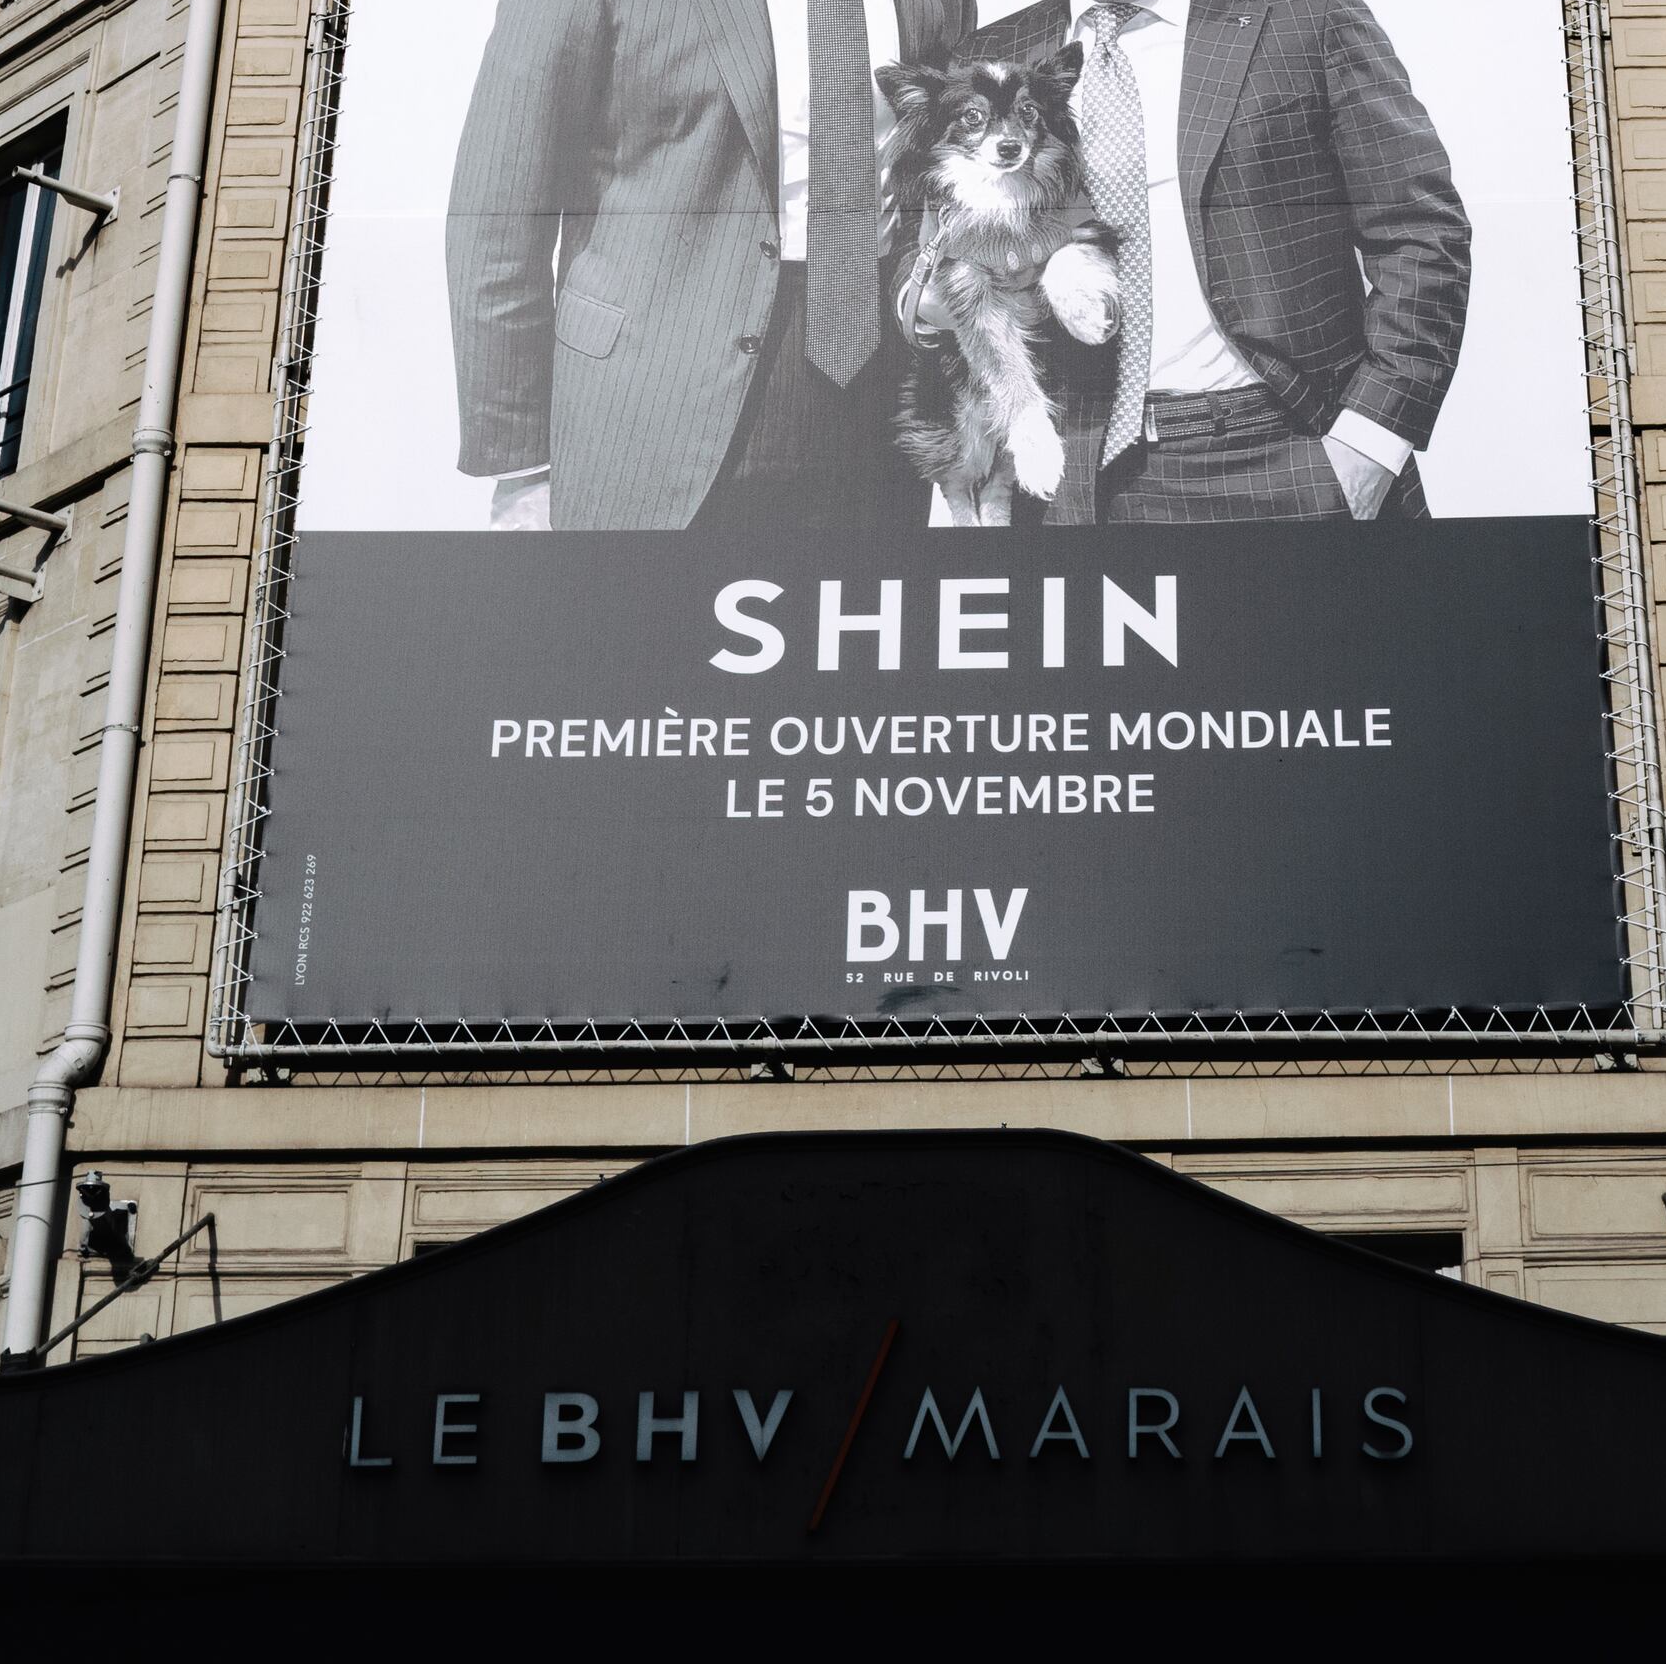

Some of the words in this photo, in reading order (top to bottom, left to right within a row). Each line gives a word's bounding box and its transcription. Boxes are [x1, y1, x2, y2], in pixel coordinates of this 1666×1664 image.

[708, 574, 1179, 675] SHEIN
[490, 706, 752, 758] PREMIÈRE
[769, 713, 1090, 756] OUVERTURE
[1110, 709, 1393, 751] MONDIALE
[726, 778, 786, 818] LE
[805, 778, 835, 818] 5
[854, 773, 1156, 817] NOVEMBRE
[306, 854, 317, 875] 269
[303, 878, 315, 899] 623
[301, 902, 313, 924] 922
[846, 887, 1030, 963] BHV
[298, 926, 310, 950] RCS
[294, 953, 308, 986] LYON
[845, 972, 865, 984] 52
[883, 972, 915, 983] RUE
[933, 971, 955, 982] DE
[973, 970, 1030, 982] RIVOLI
[349, 1395, 480, 1466] LE
[541, 1390, 793, 1462] BHV
[904, 1385, 1413, 1459] MARAIS
